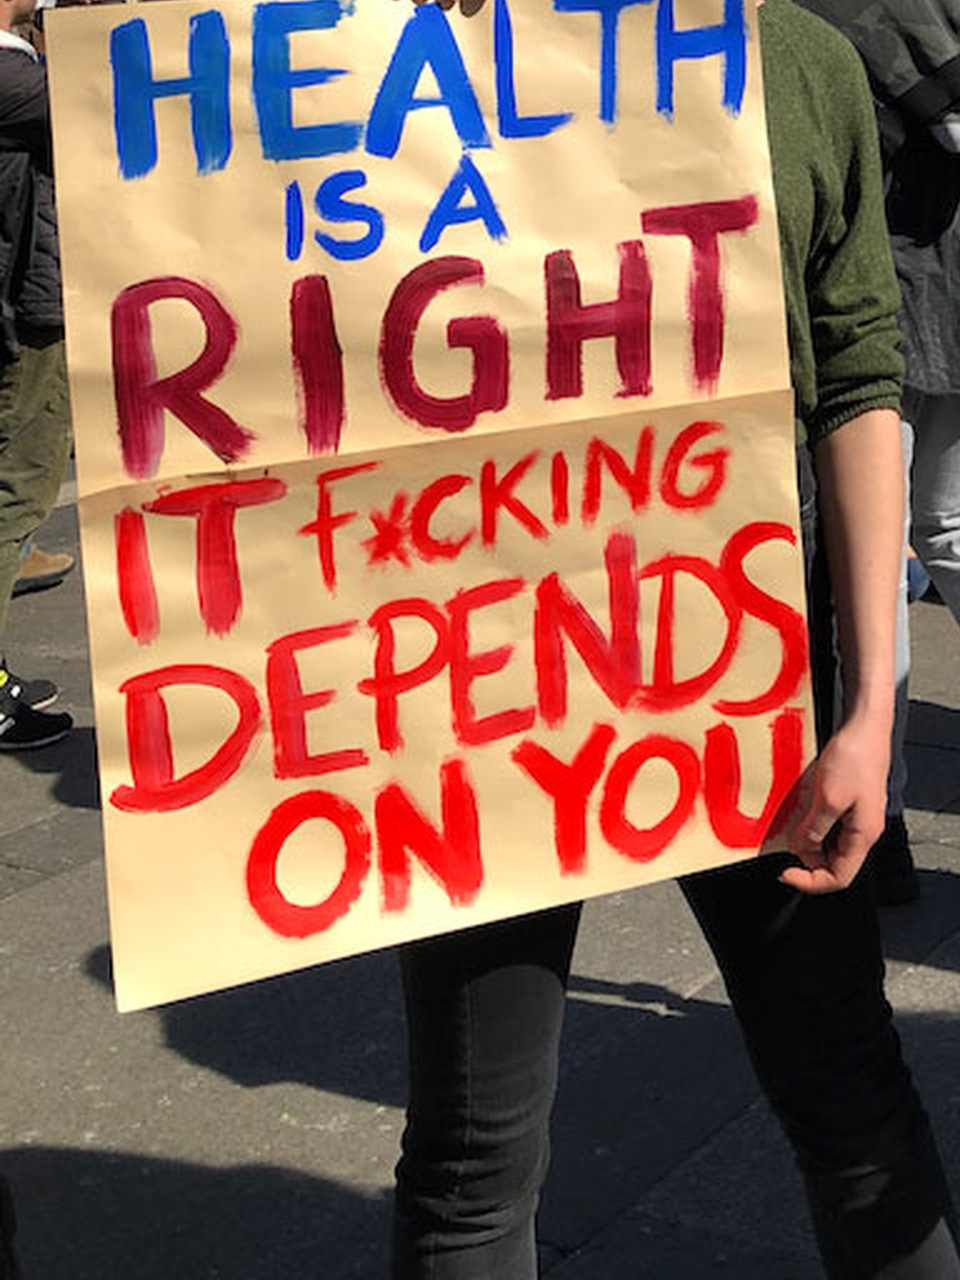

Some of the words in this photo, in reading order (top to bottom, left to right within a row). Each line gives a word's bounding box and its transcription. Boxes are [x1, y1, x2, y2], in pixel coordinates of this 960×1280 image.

[286, 171, 385, 260] IS
[420, 155, 506, 252] A
[111, 196, 758, 479] RIGHT
[111, 522, 806, 812] DEPENDS
[114, 476, 288, 644] IT
[246, 758, 483, 938] ON
[512, 708, 805, 876] YOU
